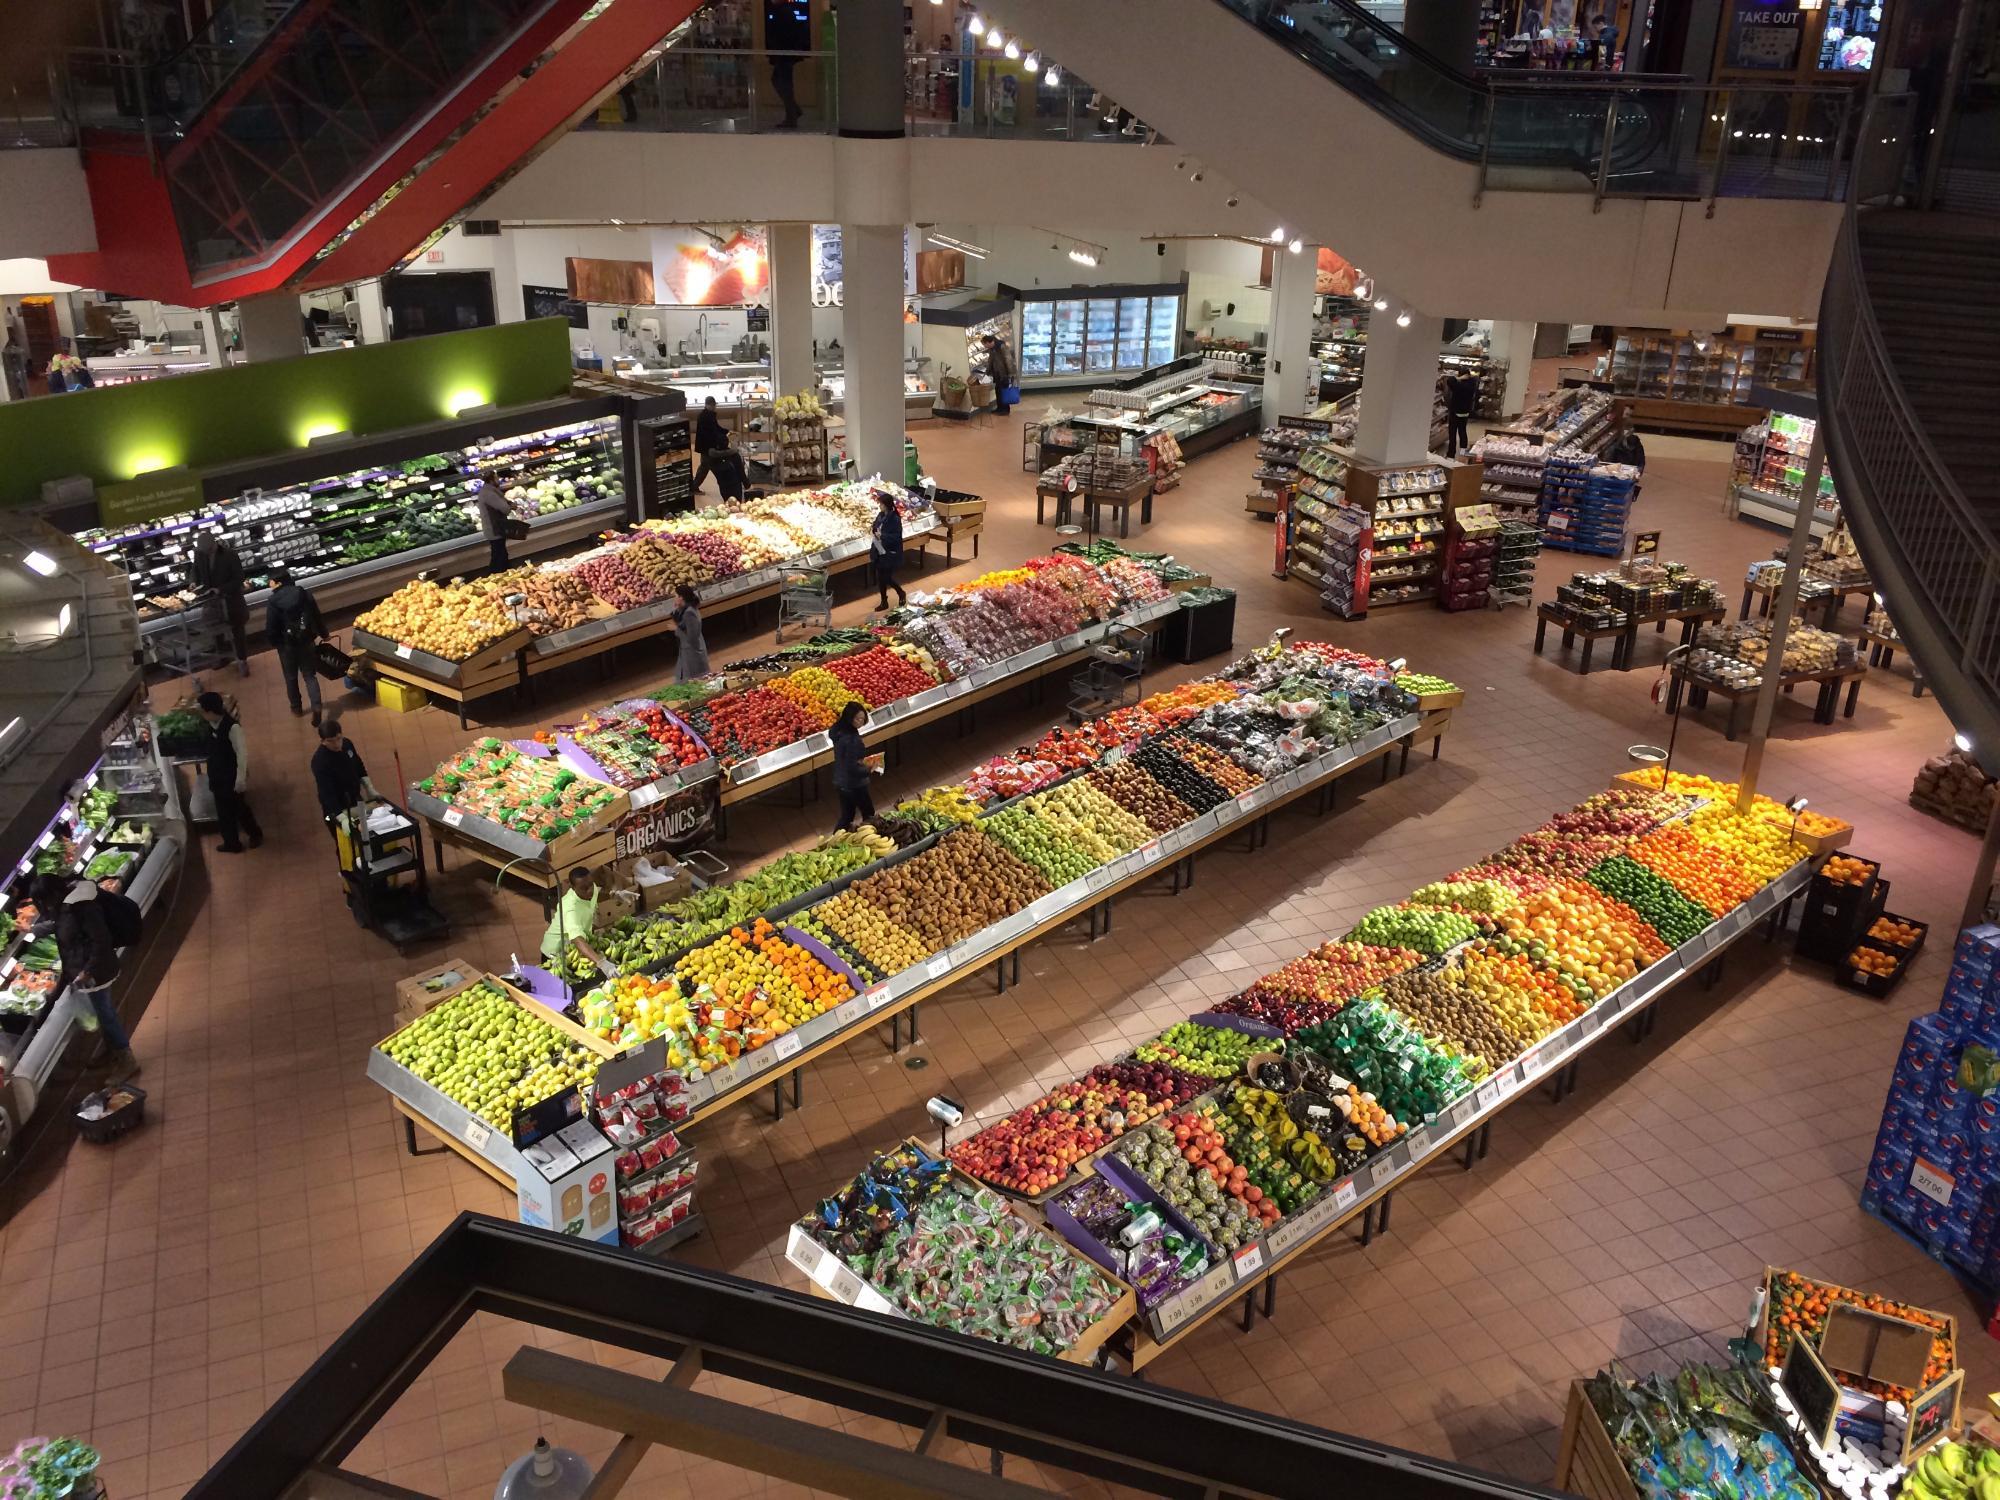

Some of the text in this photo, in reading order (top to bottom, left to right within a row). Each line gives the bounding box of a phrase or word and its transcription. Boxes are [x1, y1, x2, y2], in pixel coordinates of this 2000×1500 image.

[1738, 11, 1799, 24] TAKE OUT
[627, 806, 695, 854] ORGANICS
[616, 834, 627, 859] GOOD
[1238, 1019, 1269, 1031] Organic
[1214, 1278, 1228, 1291] 4.99
[1190, 1294, 1203, 1308] 3.99
[1168, 1308, 1183, 1323] 7.99
